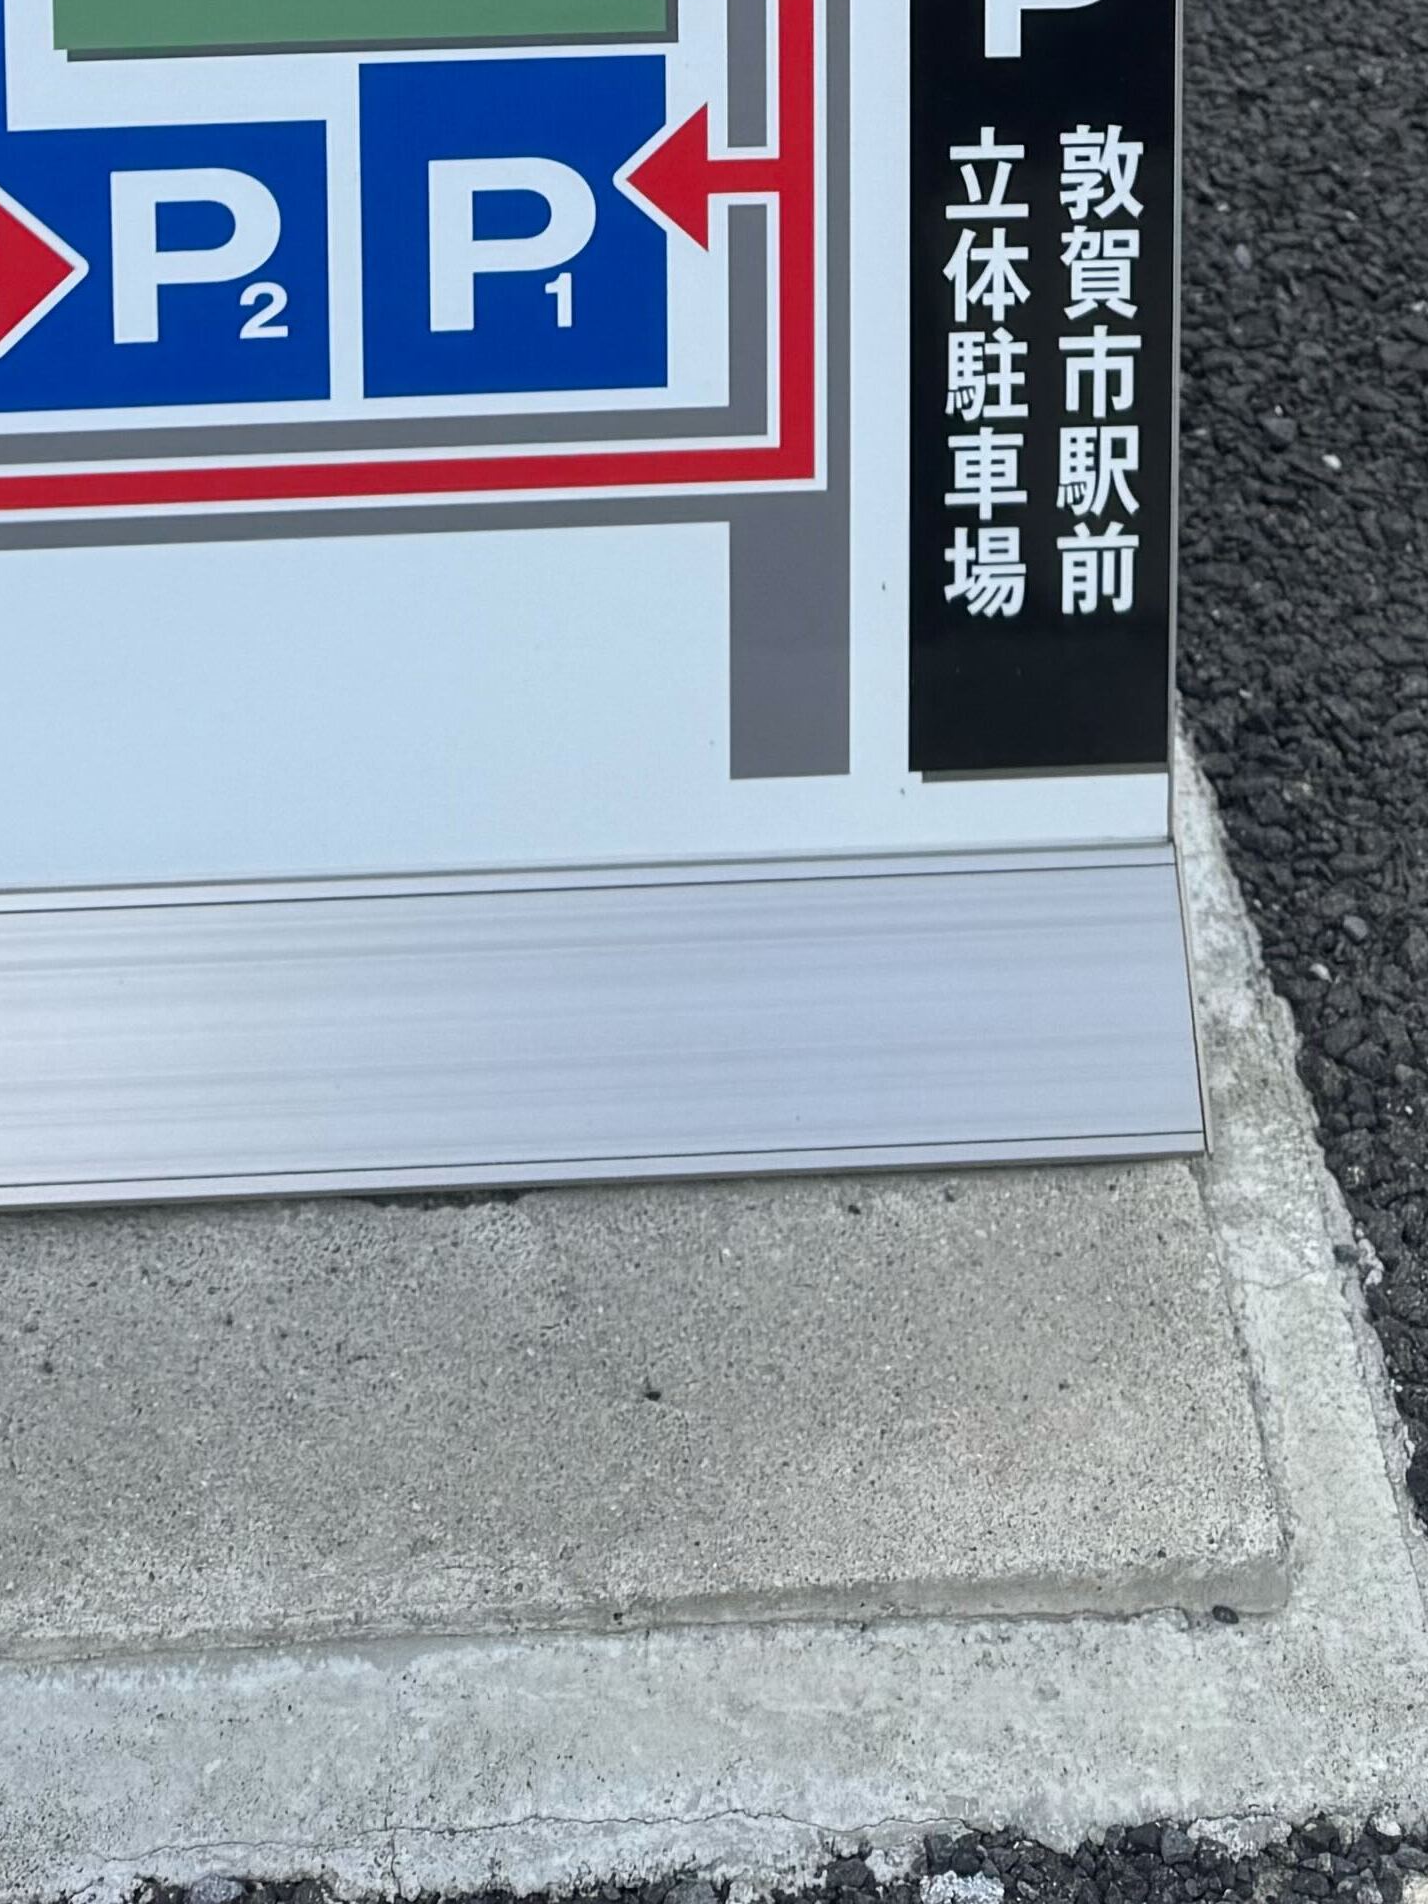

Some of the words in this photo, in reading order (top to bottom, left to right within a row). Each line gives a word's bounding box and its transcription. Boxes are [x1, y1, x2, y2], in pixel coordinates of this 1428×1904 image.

[942, 125, 1032, 619] 立体駐車場
[1056, 123, 1145, 616] 敦賀市駅前
